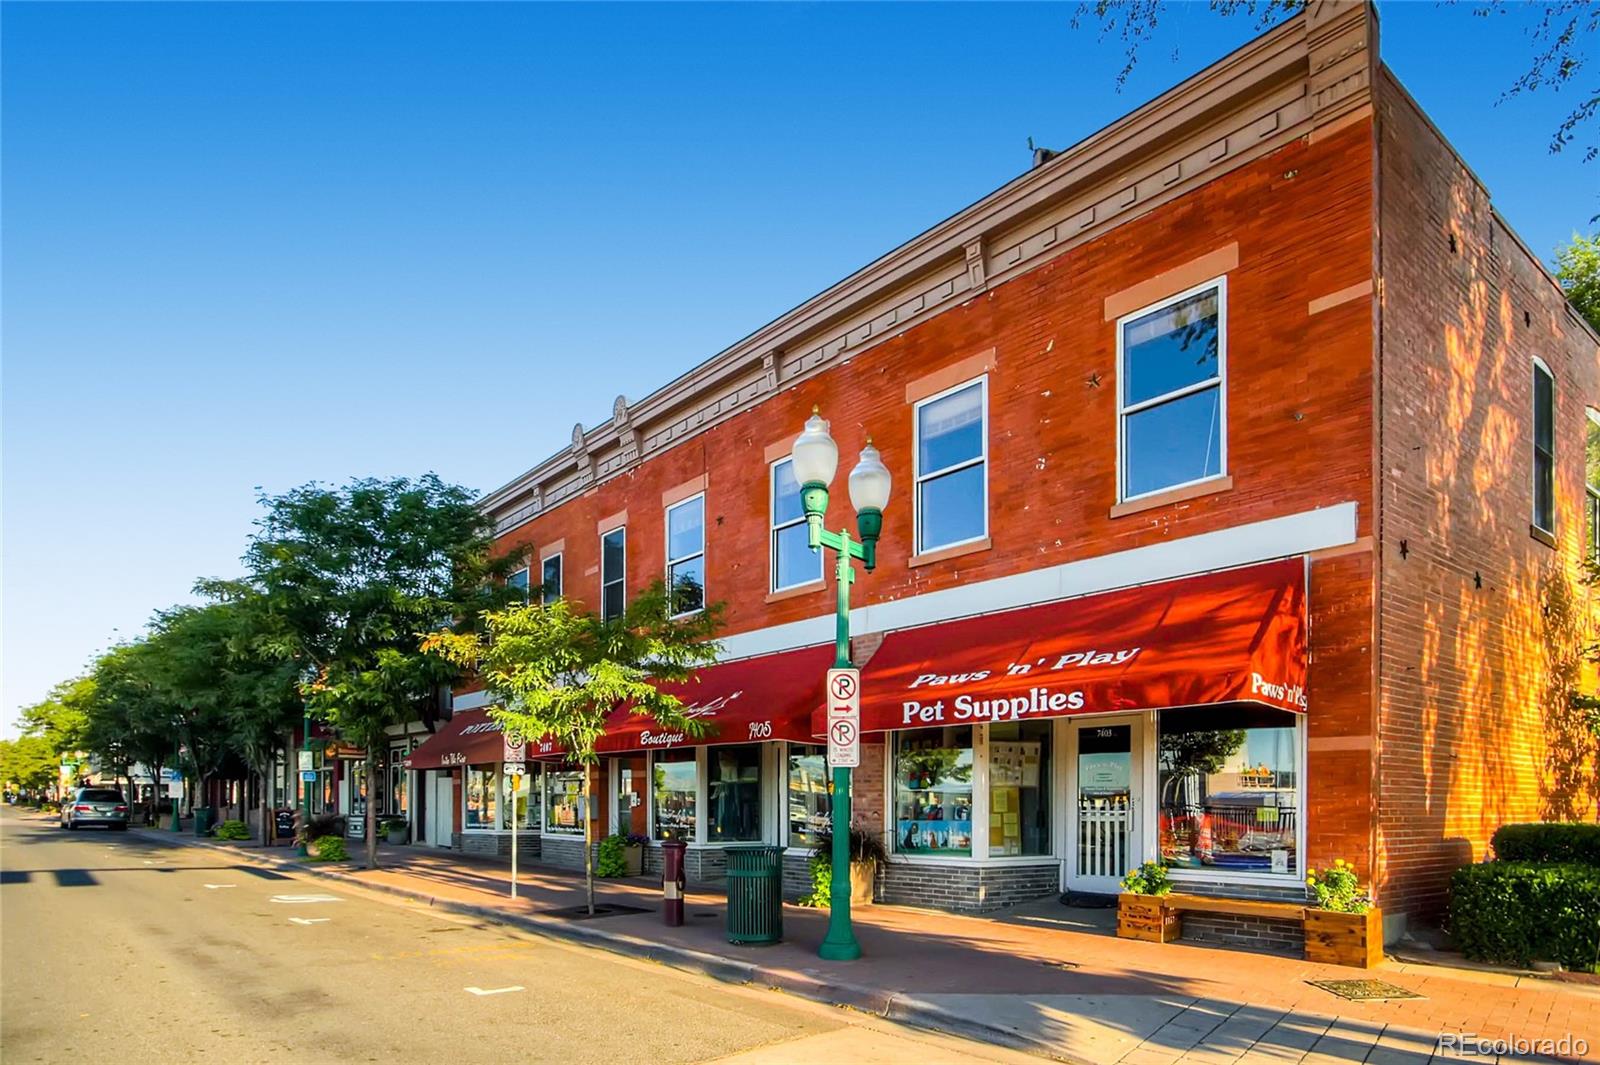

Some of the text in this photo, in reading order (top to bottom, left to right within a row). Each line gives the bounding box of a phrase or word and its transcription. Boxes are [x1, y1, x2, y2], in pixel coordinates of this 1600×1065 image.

[908, 647, 1141, 689] Paws 'n' Play
[1251, 672, 1285, 701] Paws
[902, 687, 1085, 724] Pet Supplies
[640, 729, 684, 748] Boutique
